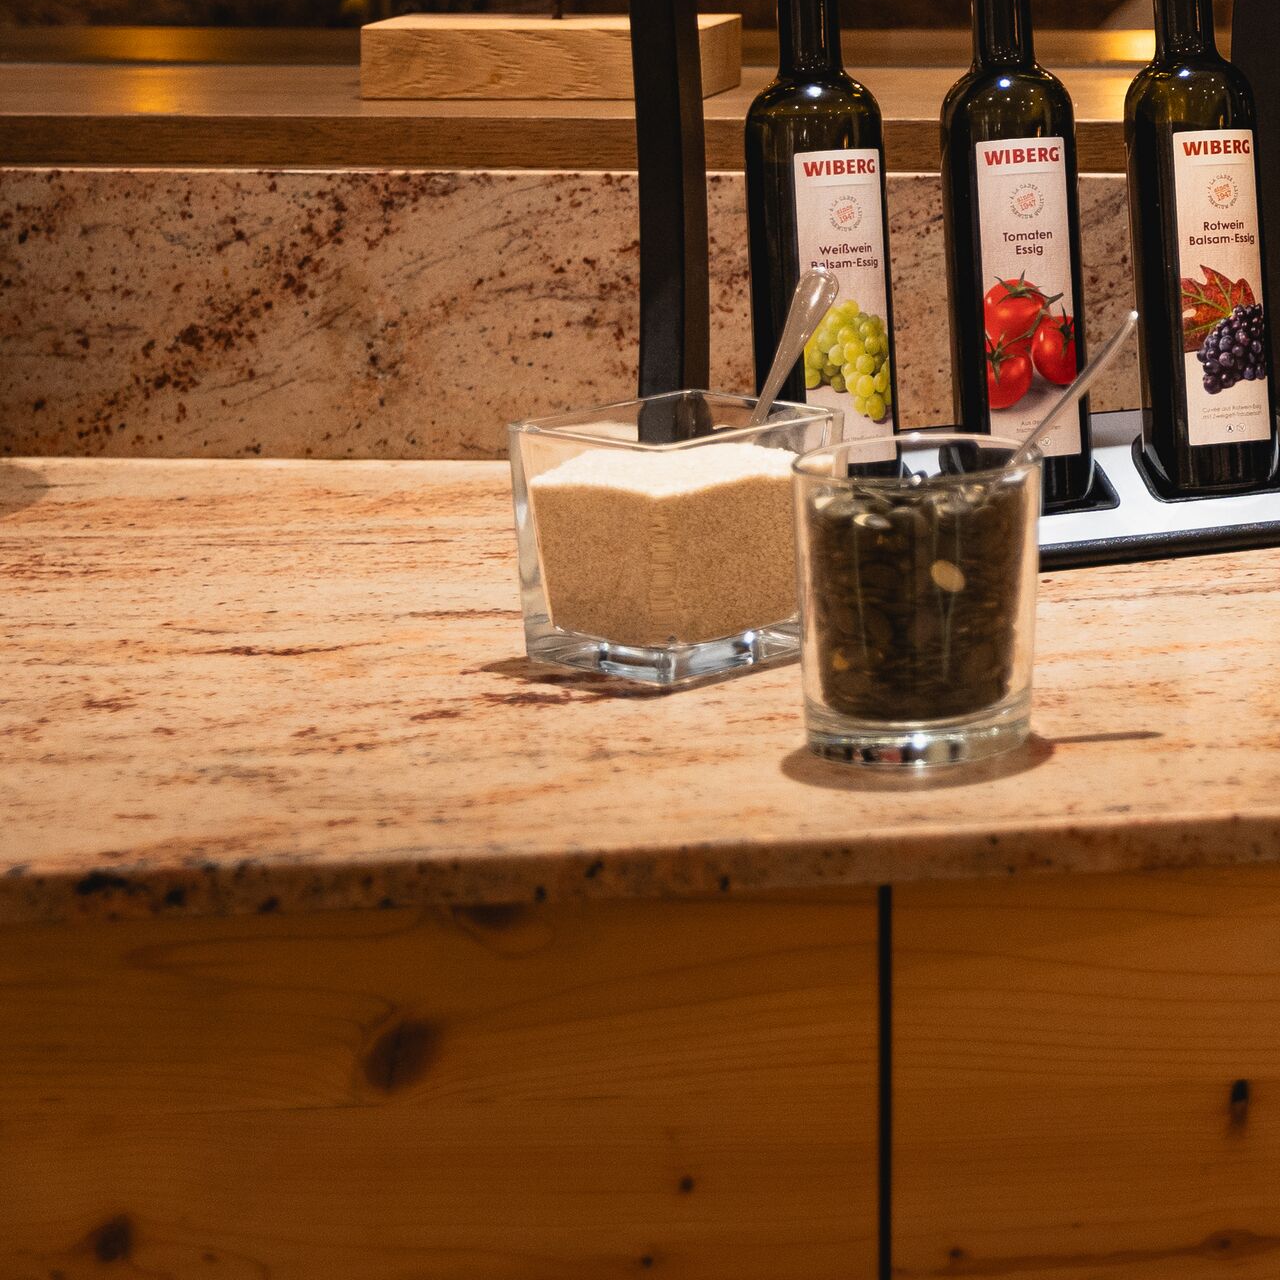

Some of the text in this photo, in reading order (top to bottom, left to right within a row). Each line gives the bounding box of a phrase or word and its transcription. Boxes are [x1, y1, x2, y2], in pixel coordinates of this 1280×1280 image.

[1183, 139, 1250, 157] WIBERG
[984, 147, 1059, 166] WIBERG
[802, 158, 875, 177] WIBERG
[1203, 220, 1244, 231] Rotwein
[1003, 230, 1053, 242] Tomaten
[1189, 233, 1255, 246] Balsam-Essig
[819, 242, 872, 255] Weißwein
[1015, 244, 1043, 256] Essig
